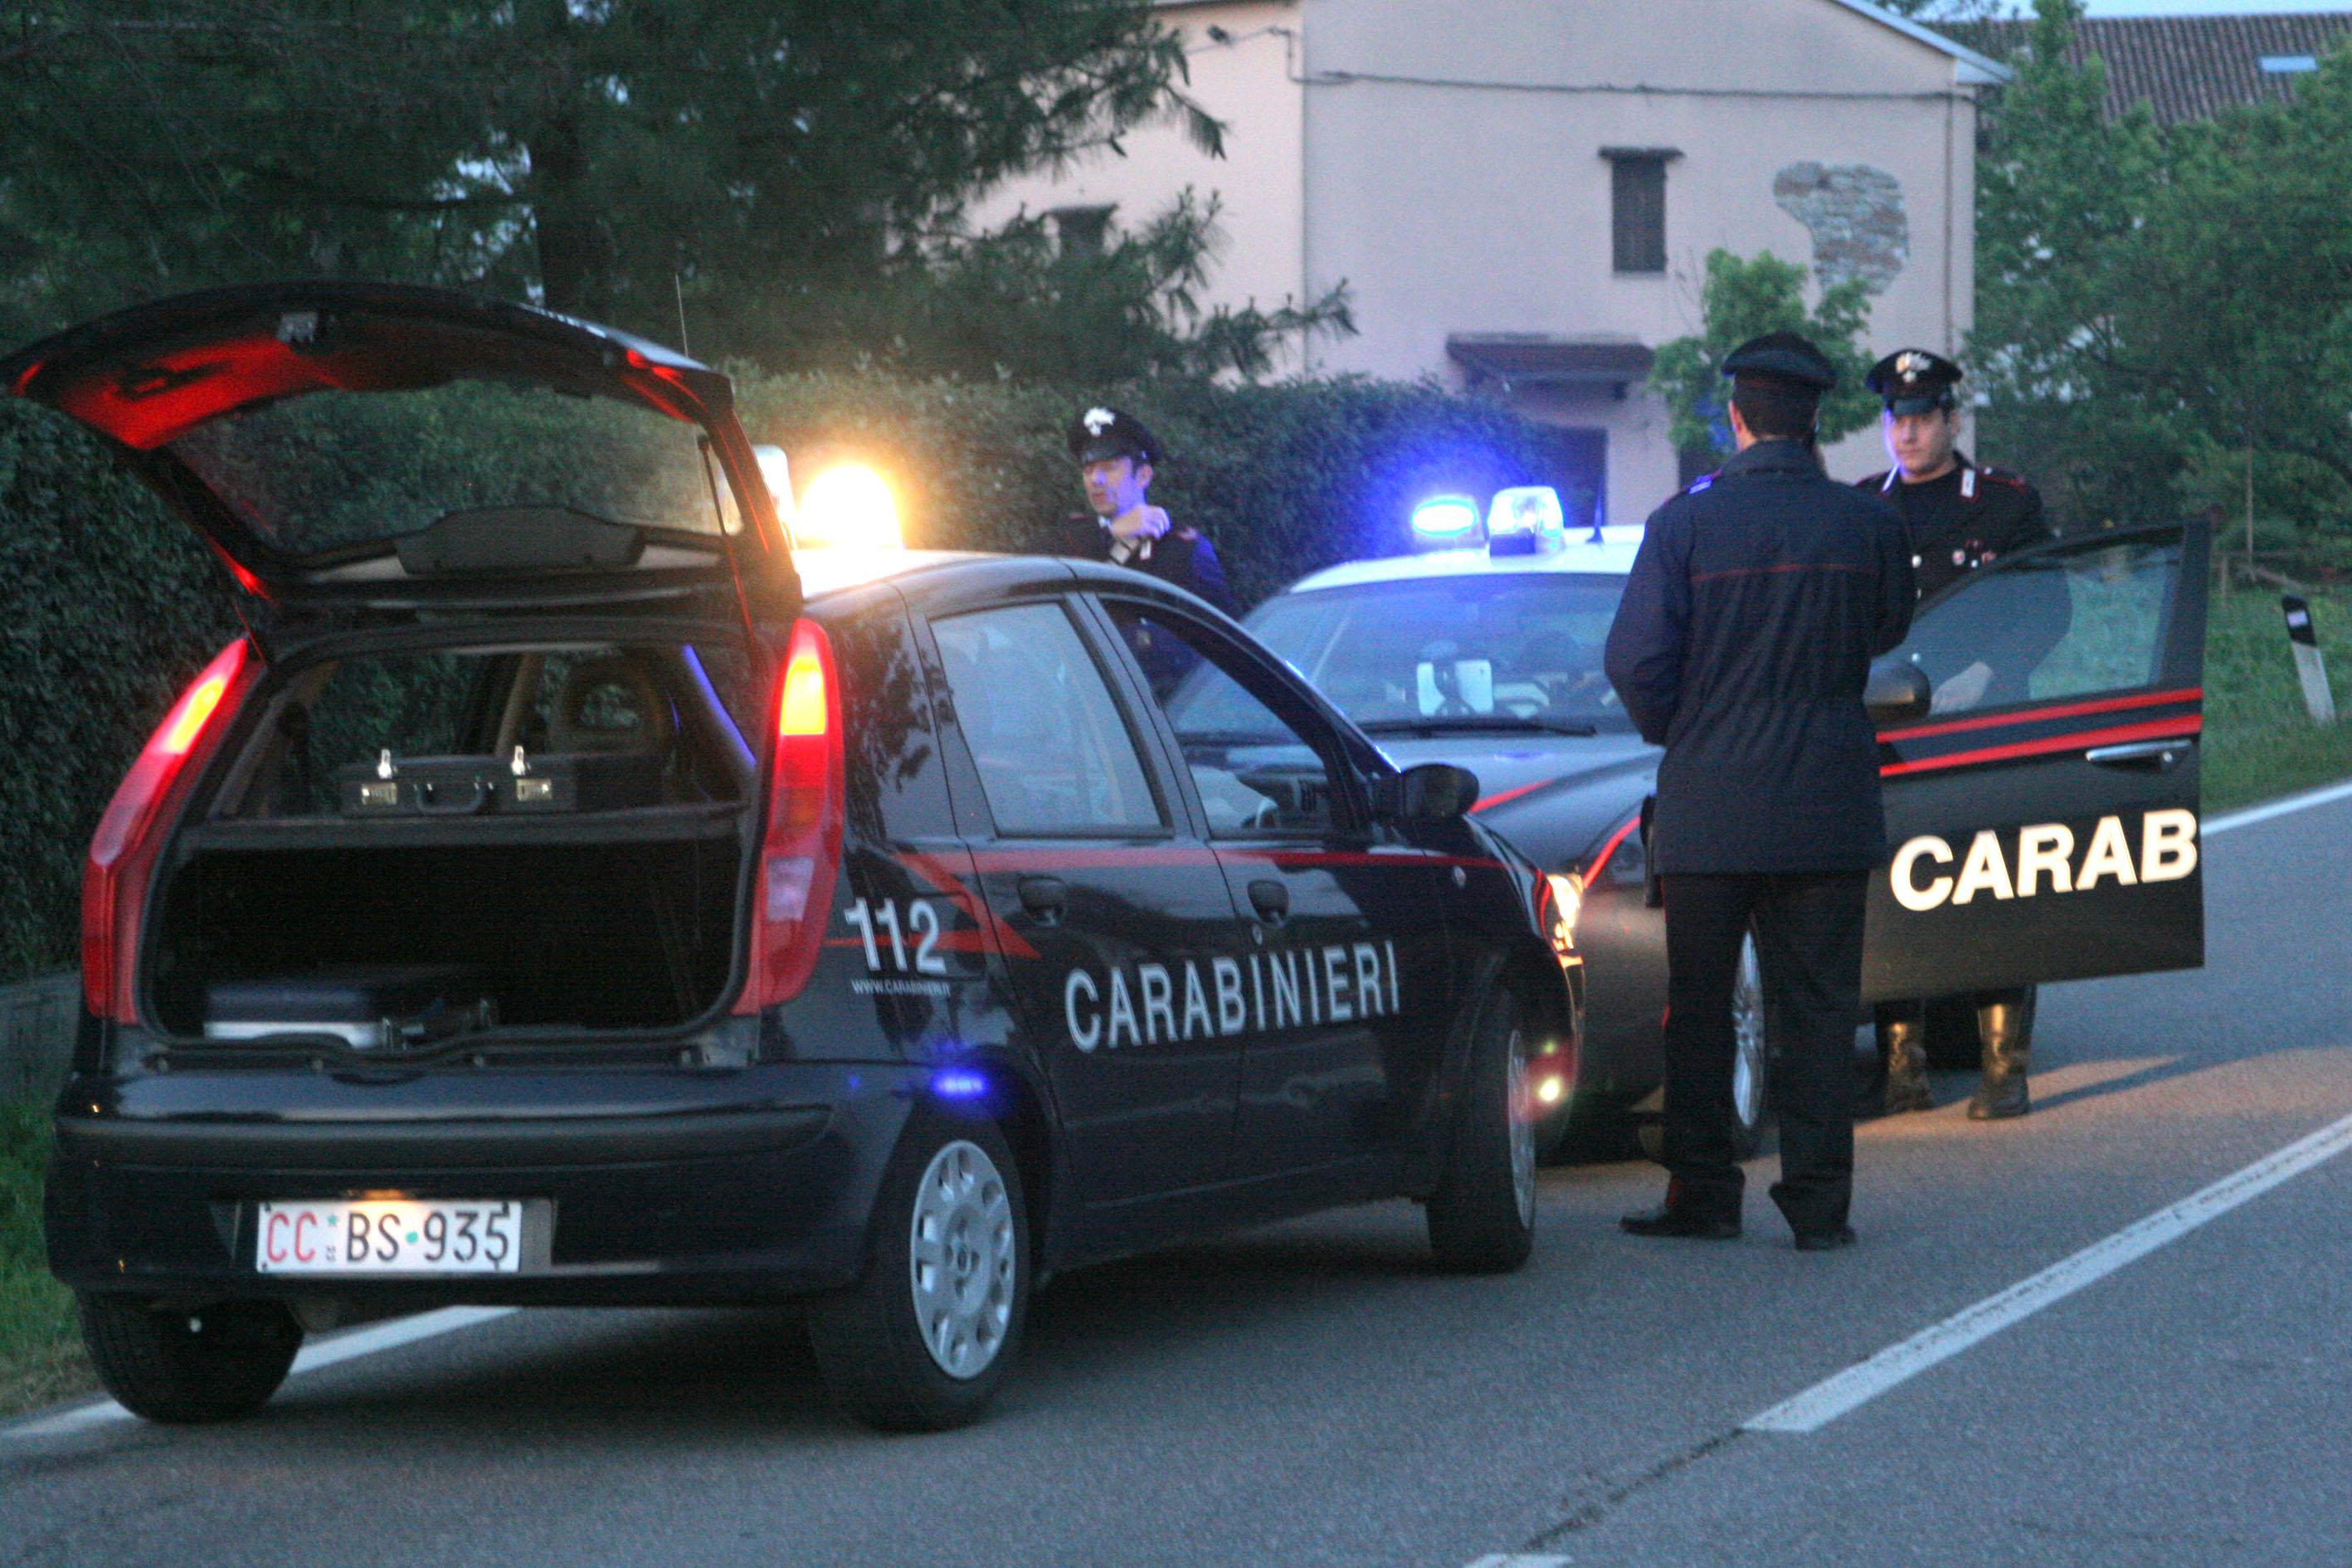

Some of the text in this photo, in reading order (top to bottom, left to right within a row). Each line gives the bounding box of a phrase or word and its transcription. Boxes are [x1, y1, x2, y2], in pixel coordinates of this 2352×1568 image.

[1891, 809, 2198, 911] CARAB
[845, 898, 947, 973] 112
[1064, 940, 1400, 1053] CARABINIERI
[266, 1211, 509, 1263] CC BS 935
